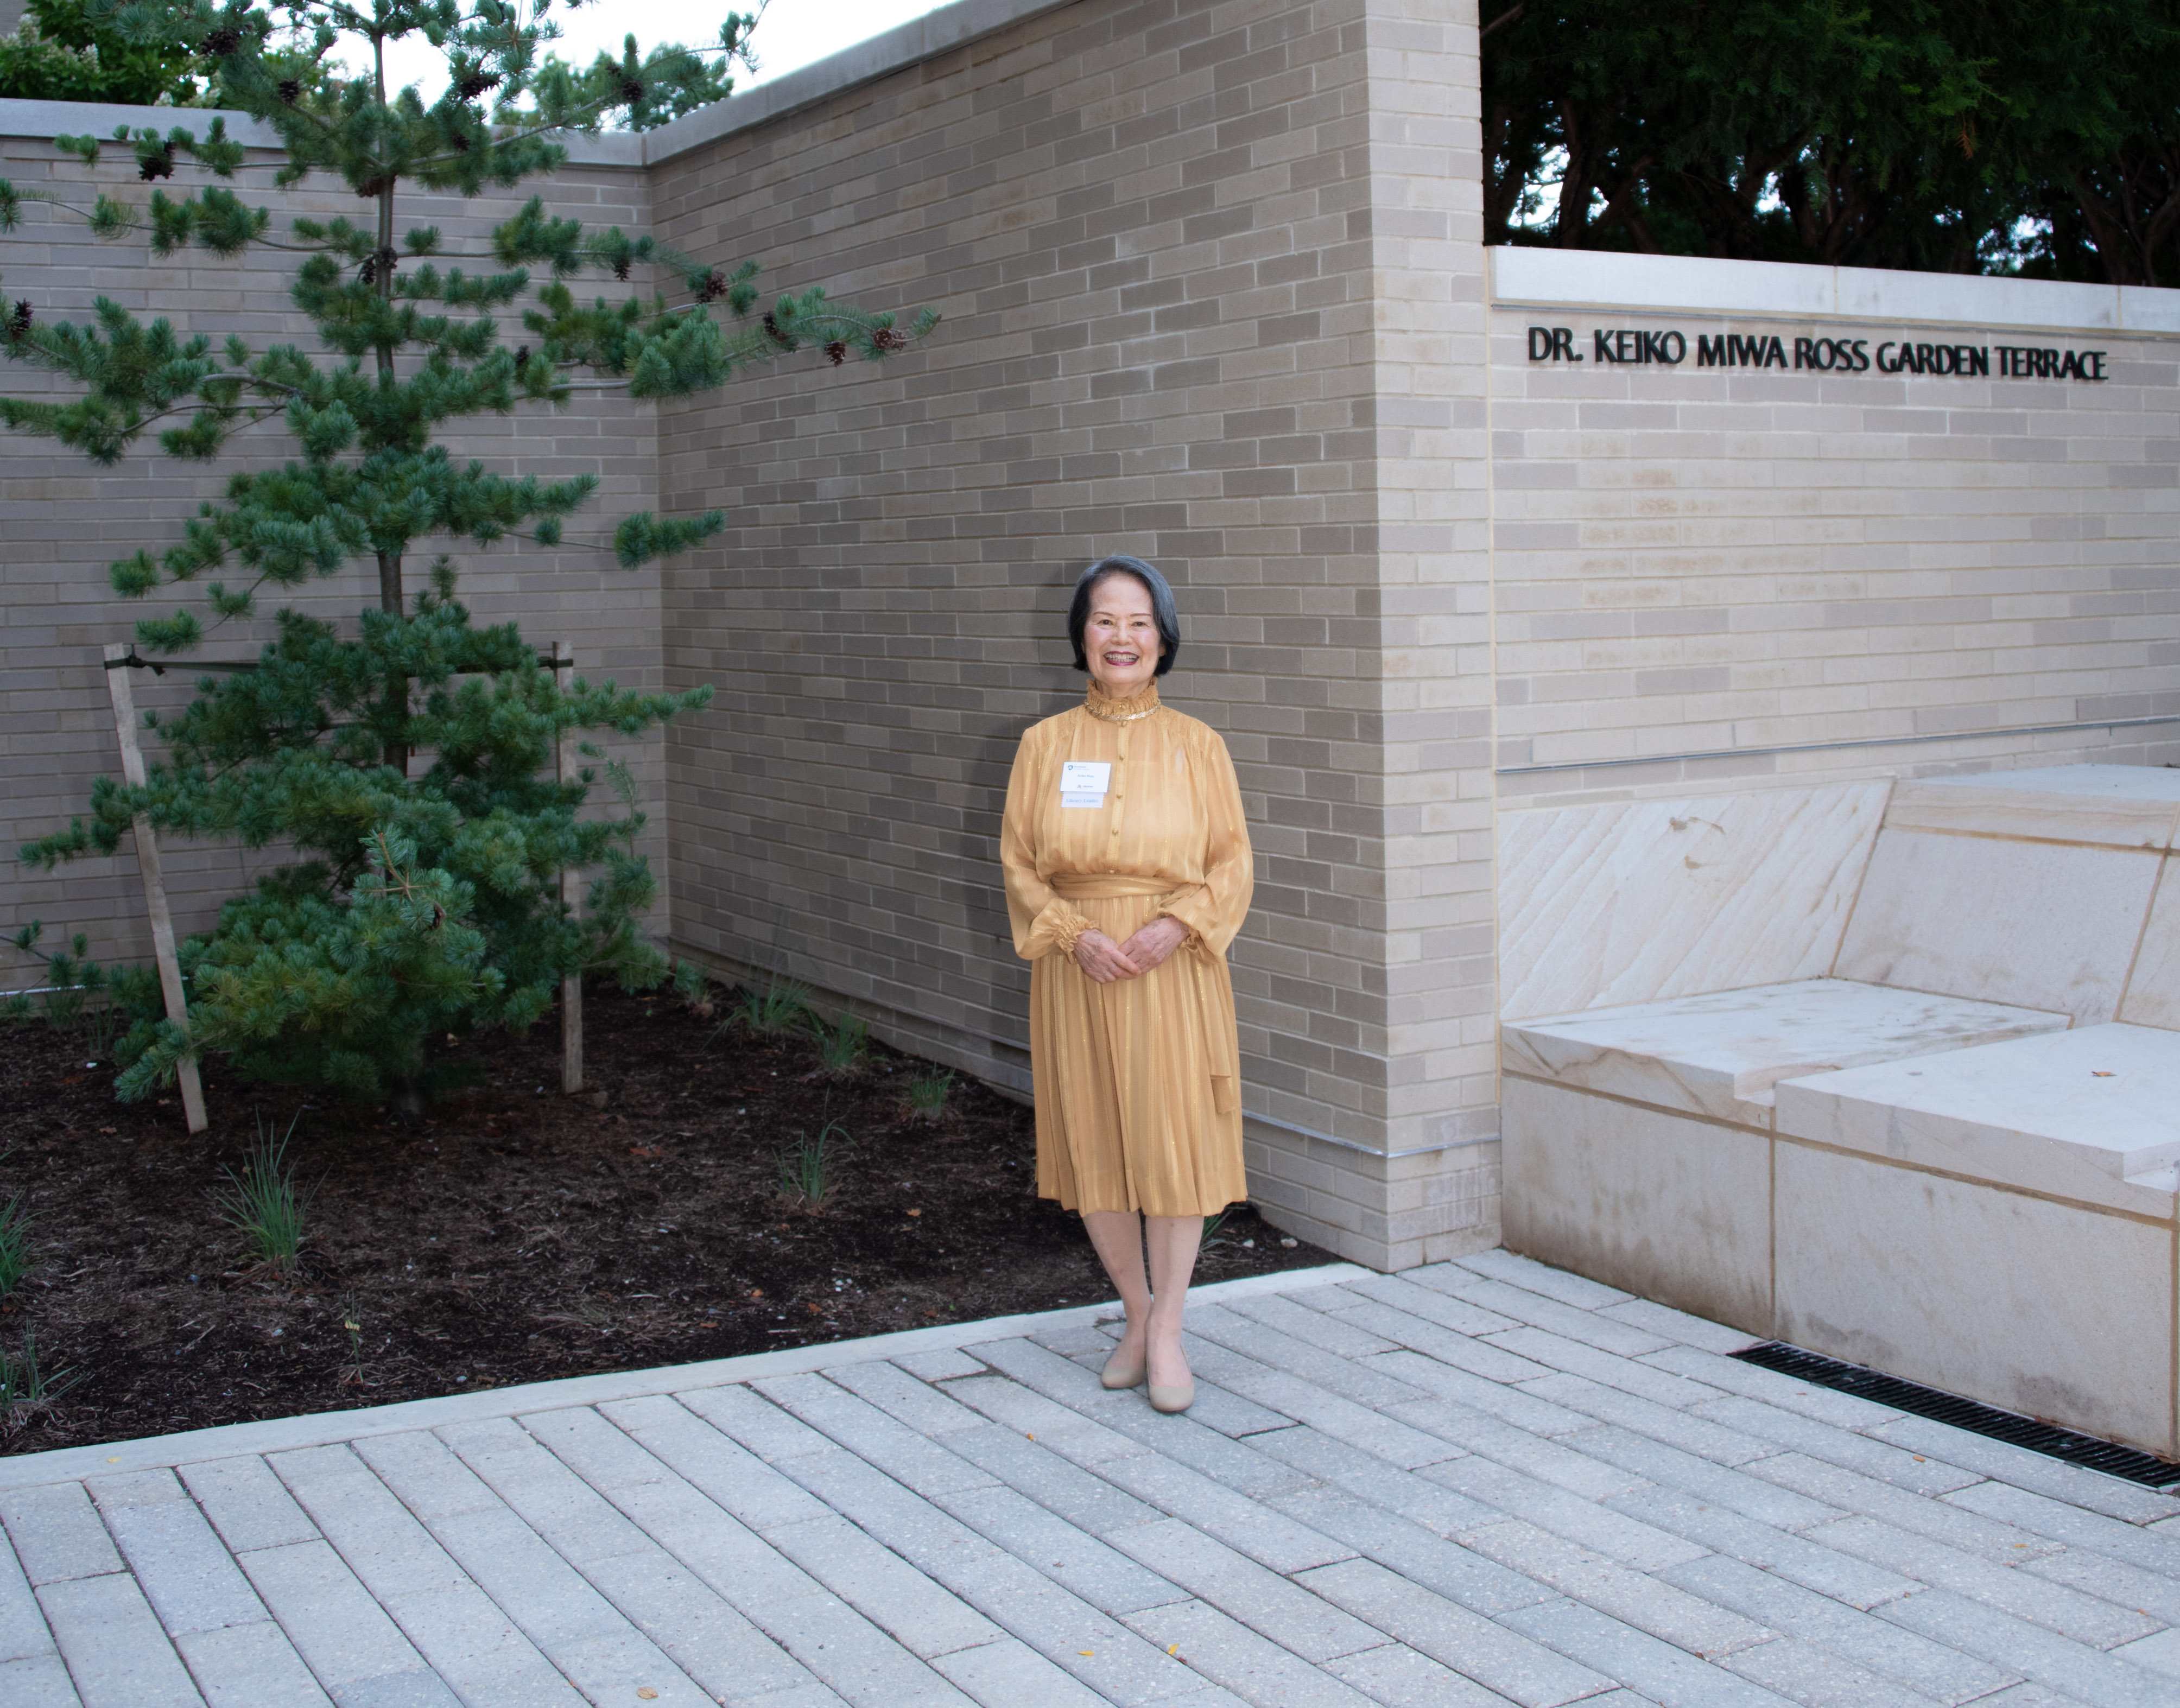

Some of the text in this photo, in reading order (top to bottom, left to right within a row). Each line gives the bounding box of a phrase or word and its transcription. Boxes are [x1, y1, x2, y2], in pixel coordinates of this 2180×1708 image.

[1528, 326, 2109, 380] DR. KEIKO MIWA ROSS GARDEN TERRACE
